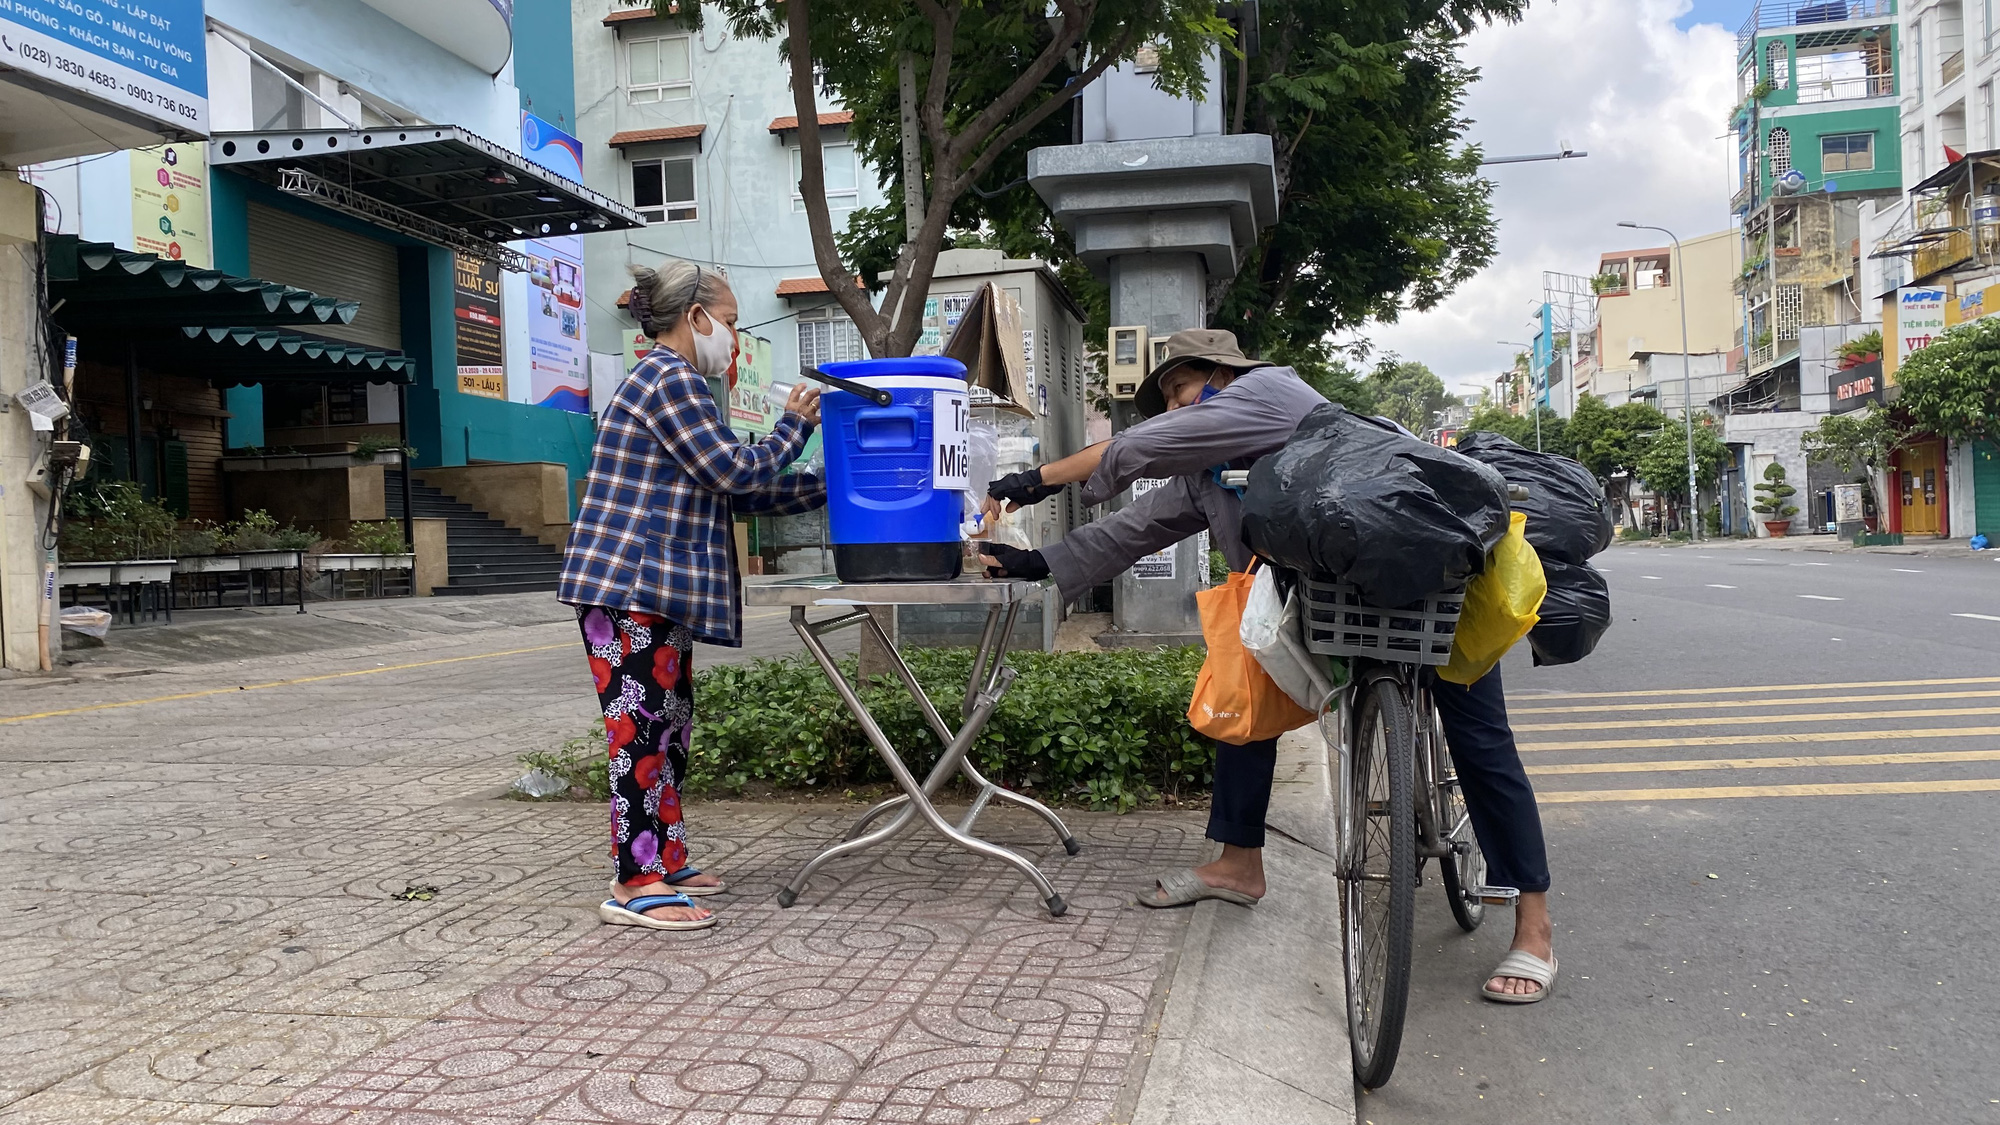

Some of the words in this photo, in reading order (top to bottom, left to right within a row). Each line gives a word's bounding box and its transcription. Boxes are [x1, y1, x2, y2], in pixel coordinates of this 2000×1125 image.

[112, 20, 136, 39] MÀN
[150, 14, 171, 31] ĐẠT
[15, 3, 59, 30] PHÒNG
[69, 25, 110, 50] KHÁCH
[112, 42, 135, 60] SẠN
[143, 54, 159, 69] TƯ
[160, 62, 179, 79] GIA
[20, 42, 52, 68] (028)
[55, 56, 85, 78] 3830
[88, 69, 117, 90] 4683
[127, 83, 154, 103] 0903
[156, 94, 176, 112] 736
[178, 103, 198, 120] 032
[457, 271, 483, 293] LUẬT
[485, 280, 499, 296] SƯ
[1902, 291, 1945, 303] MPE
[1903, 319, 1923, 329] TIỆM
[1924, 319, 1944, 328] ĐIỆN
[463, 377, 475, 388] 501
[1837, 382, 1854, 401] ART
[1854, 376, 1875, 397] HAIR
[939, 439, 970, 478] Miễ
